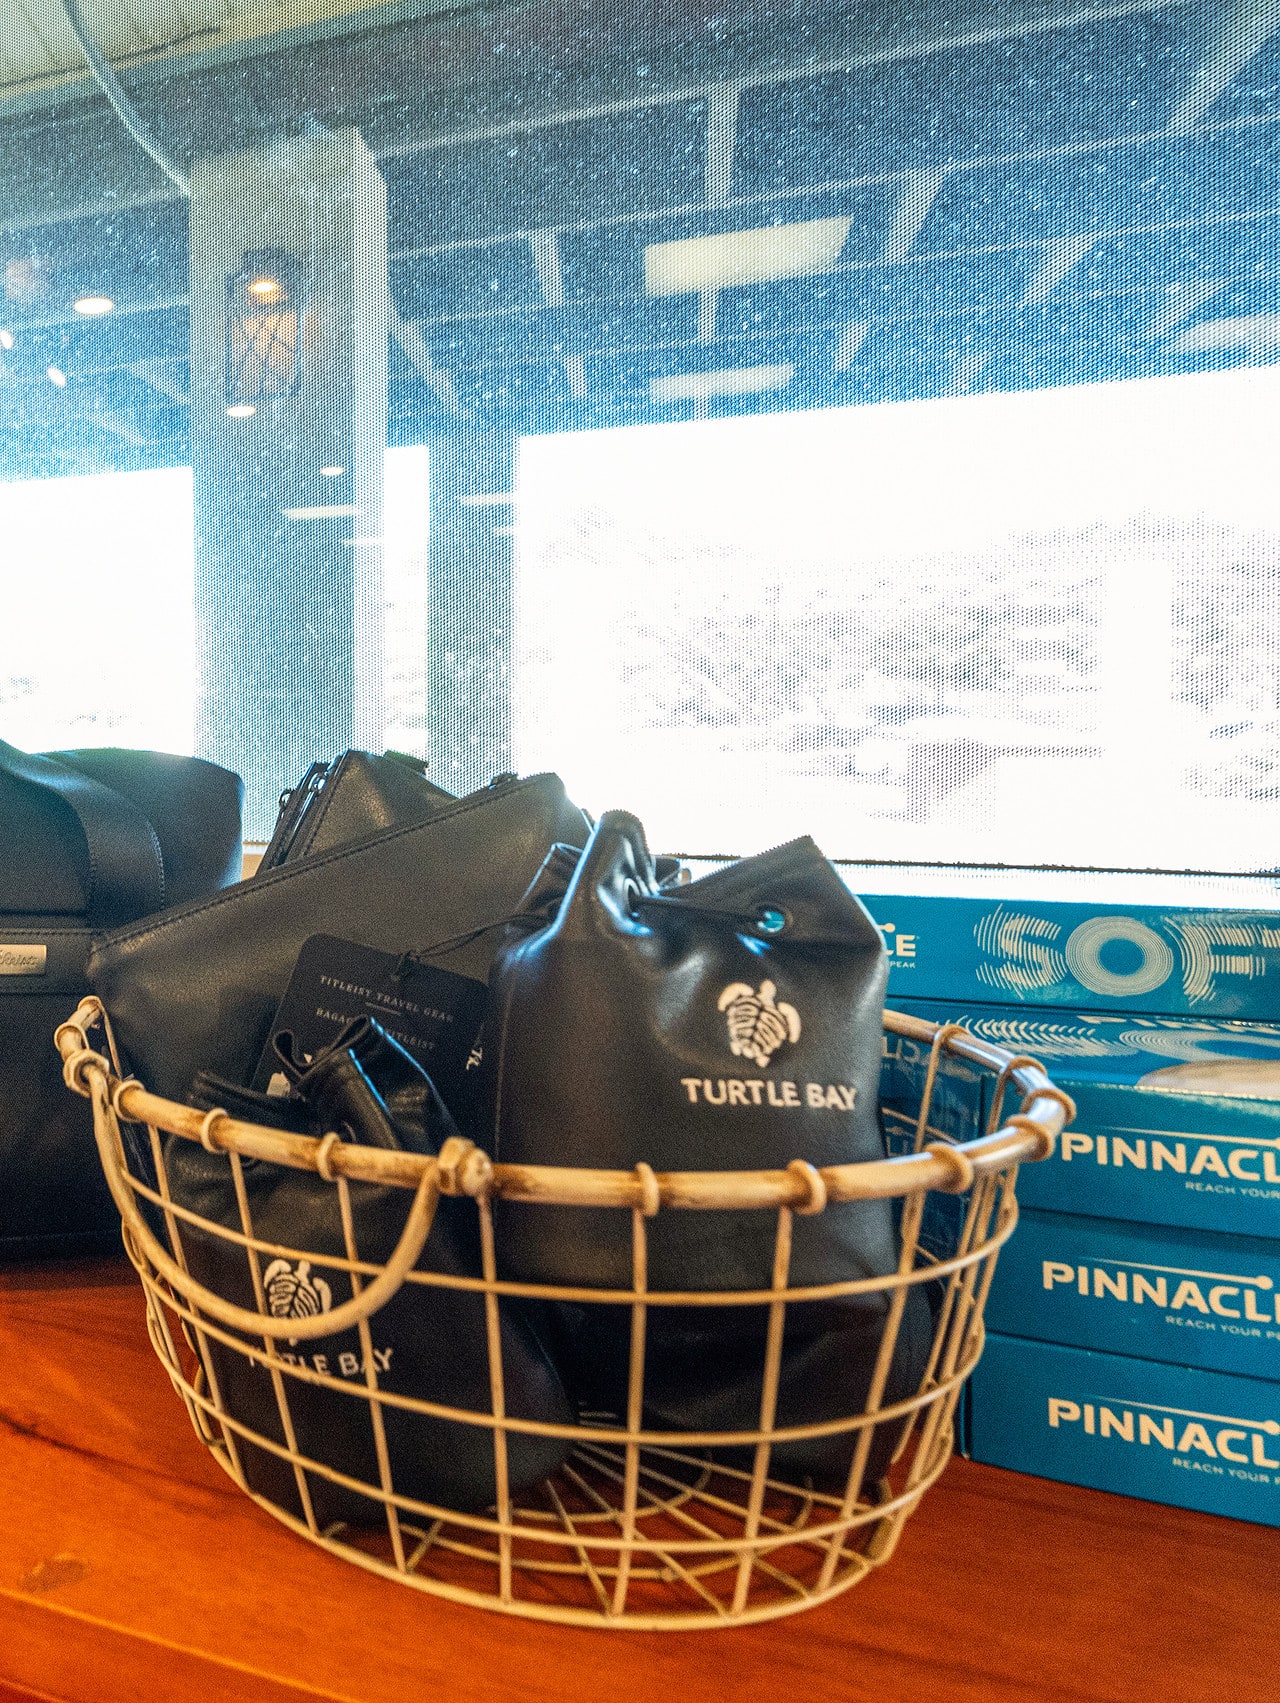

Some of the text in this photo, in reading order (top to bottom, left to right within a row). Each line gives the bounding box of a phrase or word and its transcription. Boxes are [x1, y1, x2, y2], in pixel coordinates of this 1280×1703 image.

[974, 902, 1280, 1007] SOF
[320, 975, 373, 998] TITLEIST
[375, 991, 420, 1013] TRAVEL
[681, 1077, 858, 1112] TURTLE BAY
[1185, 1181, 1280, 1200] REACH YOUR
[1042, 1260, 1280, 1325] PINNACL
[1165, 1315, 1216, 1331] REACH
[1220, 1324, 1262, 1338] YOUR
[1048, 1397, 1280, 1470] PINNACL
[1173, 1457, 1224, 1475] REACH
[1227, 1468, 1270, 1484] YOUR
